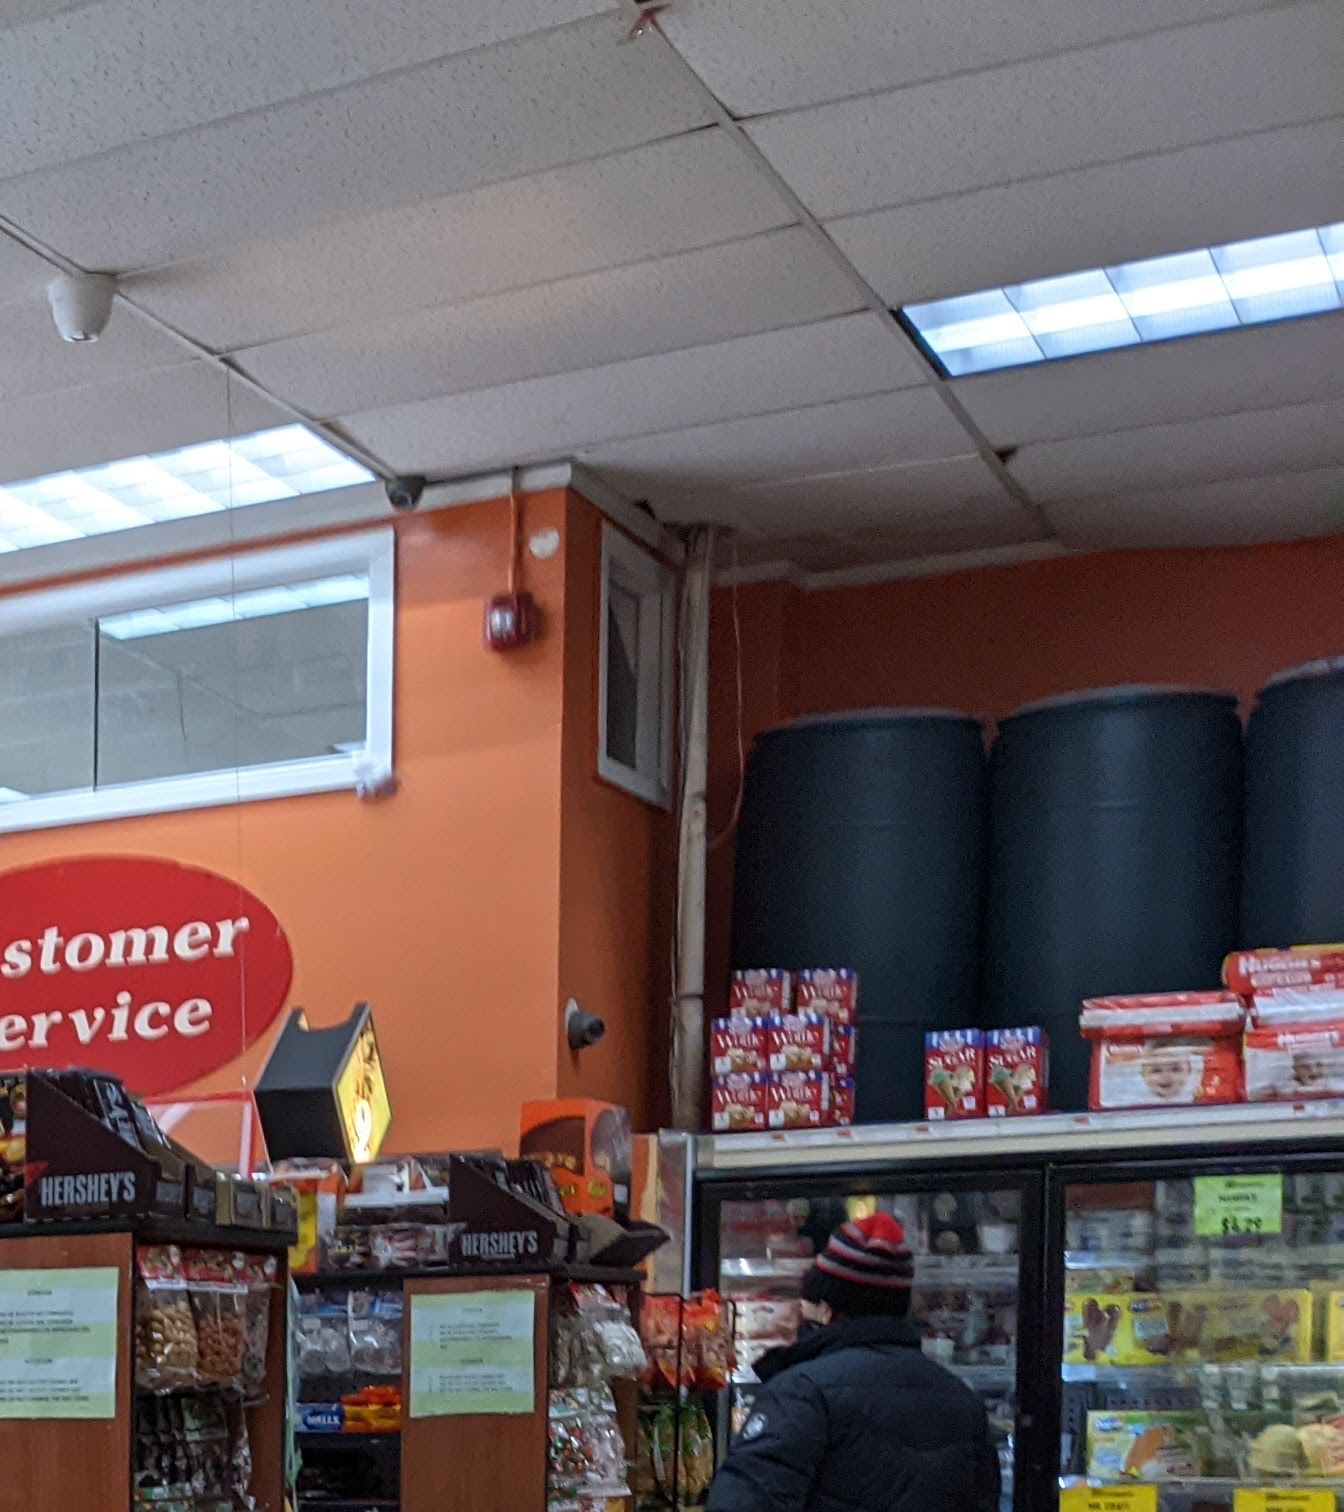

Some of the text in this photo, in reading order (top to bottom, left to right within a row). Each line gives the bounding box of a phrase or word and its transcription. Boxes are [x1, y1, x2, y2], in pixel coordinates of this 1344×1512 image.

[927, 1049, 976, 1068] SUGAR
[989, 1047, 1037, 1067] SUGAR
[40, 1172, 136, 1206] HERSHEY'S
[463, 1231, 538, 1256] HERSHEY'S
